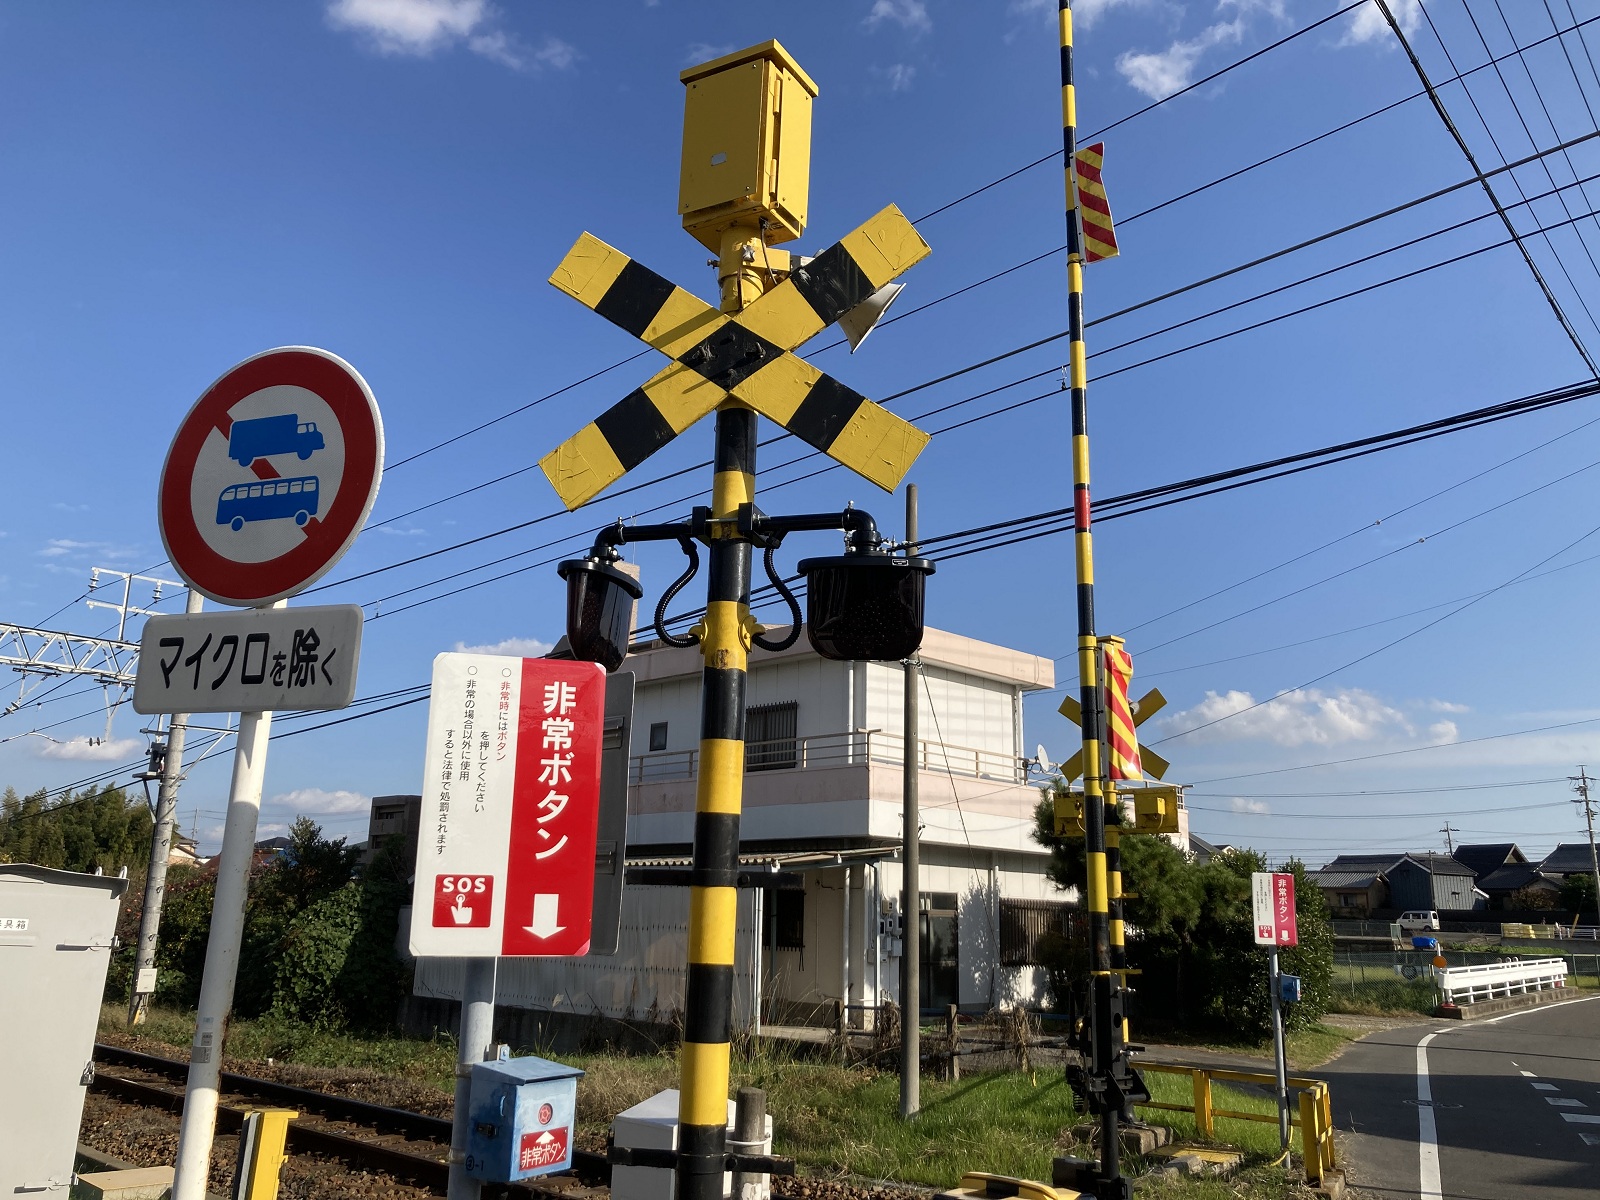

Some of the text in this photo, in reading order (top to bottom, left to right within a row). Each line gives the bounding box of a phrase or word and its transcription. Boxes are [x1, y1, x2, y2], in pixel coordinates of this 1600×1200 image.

[159, 627, 337, 691] マイクロを除く
[459, 679, 477, 782] 非常の場合以外に使用
[496, 681, 511, 761] 非常時にはボタン
[436, 729, 456, 855] すると法律で処罰されます
[475, 731, 490, 813] を押してください
[535, 681, 577, 861] 非常ボタン
[442, 877, 486, 894] SOS
[1278, 879, 1289, 923] 非常ボタン
[0, 919, 26, 930] 具箱
[521, 1142, 566, 1169] 非常ボタン
